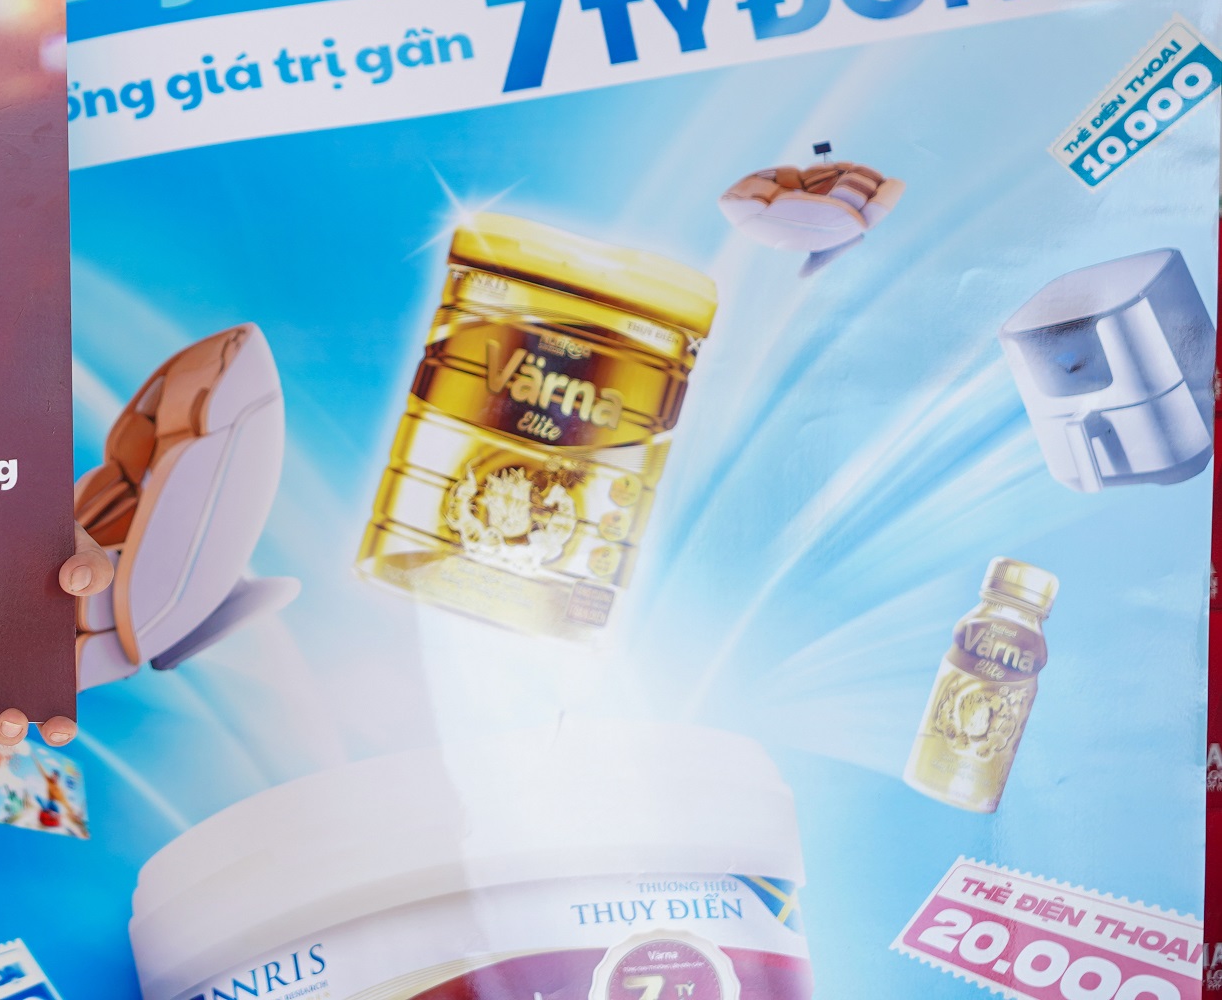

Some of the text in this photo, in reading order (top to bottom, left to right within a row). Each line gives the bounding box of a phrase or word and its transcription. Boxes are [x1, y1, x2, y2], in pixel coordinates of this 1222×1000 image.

[166, 52, 263, 111] giá
[273, 37, 347, 89] trị
[354, 27, 475, 84] gần
[1090, 94, 1127, 130] ĐIỆN
[1124, 38, 1183, 94] THOẠI
[1081, 61, 1214, 181] 10.000
[485, 338, 626, 431] Värna
[516, 410, 563, 441] Elite
[963, 622, 1036, 674] Värna
[570, 892, 744, 926] THỤY ĐIỂN
[636, 879, 739, 894] THƯƠNG HIỆU
[960, 877, 1013, 906] THẺ
[1014, 893, 1088, 930] ĐIỆN
[1093, 914, 1205, 965] THOẠI
